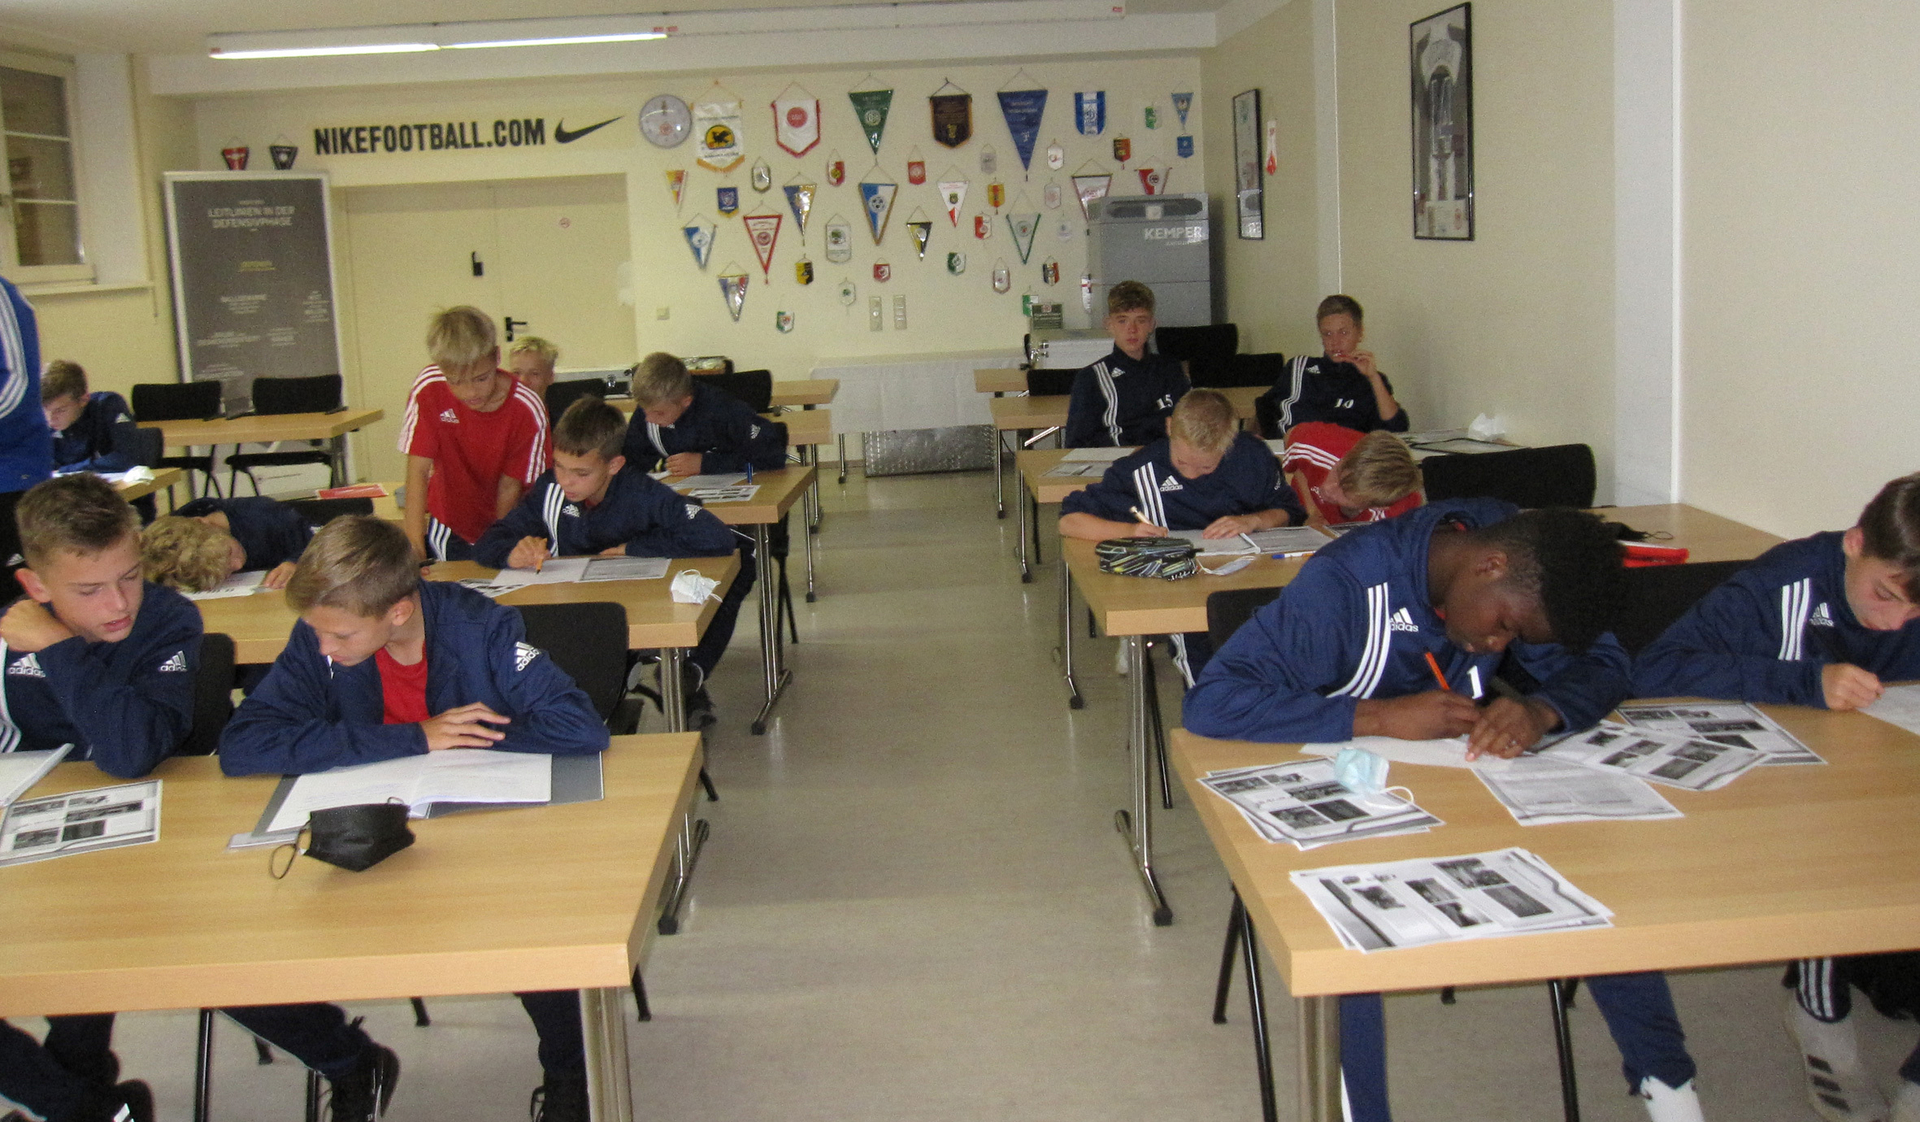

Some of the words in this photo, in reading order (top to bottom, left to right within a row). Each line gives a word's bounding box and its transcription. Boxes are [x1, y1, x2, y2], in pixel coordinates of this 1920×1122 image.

[314, 118, 546, 155] NIKEFOOTBALL.COM
[1144, 226, 1203, 240] KEMPER
[1157, 394, 1174, 410] 15
[1160, 484, 1183, 492] adidas
[1390, 620, 1419, 632] didas
[517, 648, 542, 671] adida
[7, 666, 46, 678] adidas
[1466, 664, 1483, 700] 1
